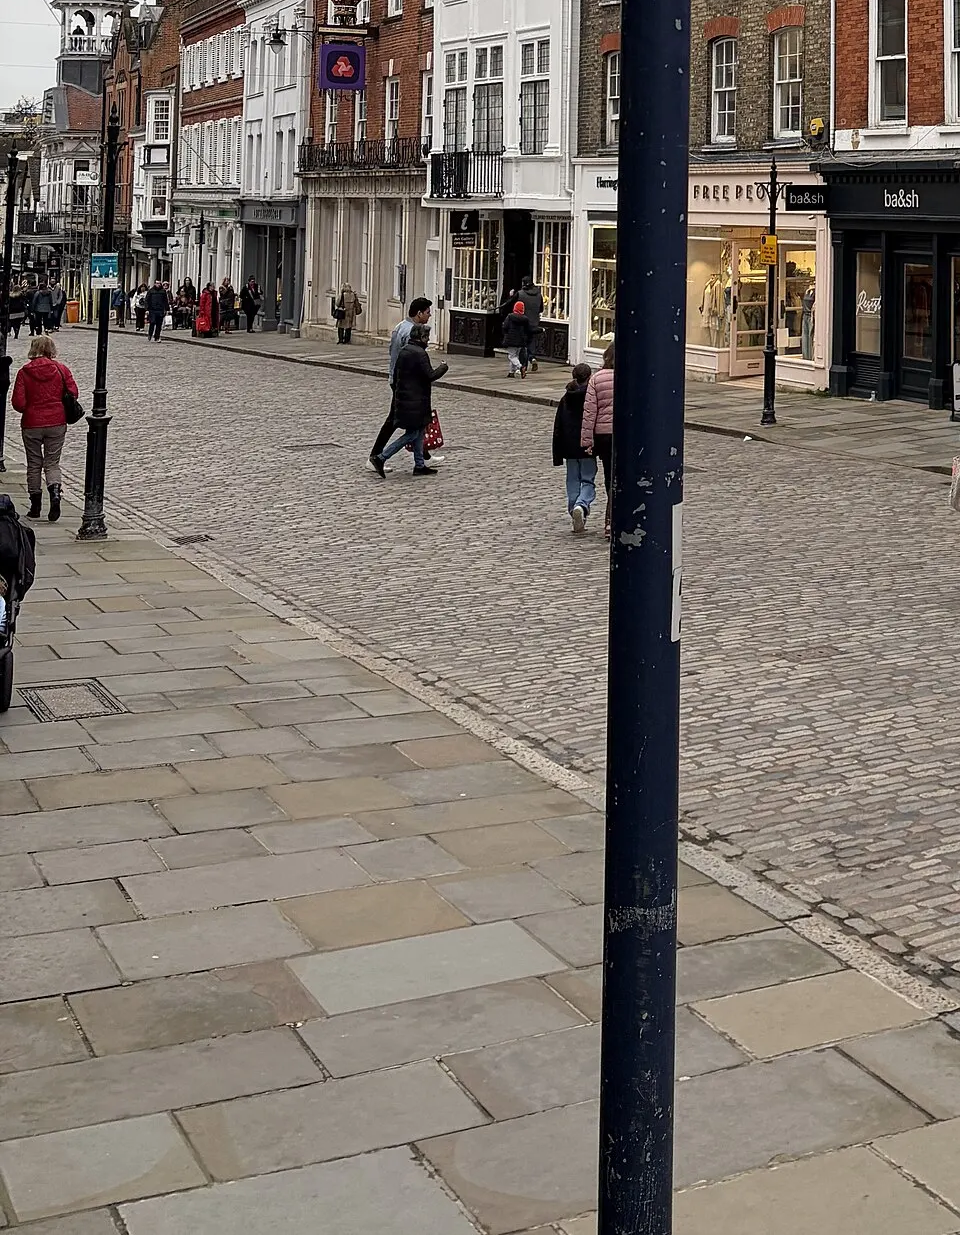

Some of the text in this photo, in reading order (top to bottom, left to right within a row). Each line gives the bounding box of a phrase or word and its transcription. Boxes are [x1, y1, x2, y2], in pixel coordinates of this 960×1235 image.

[693, 185, 786, 201] FREE PEOL
[789, 192, 824, 204] ba&sh
[884, 188, 919, 208] ba&sh
